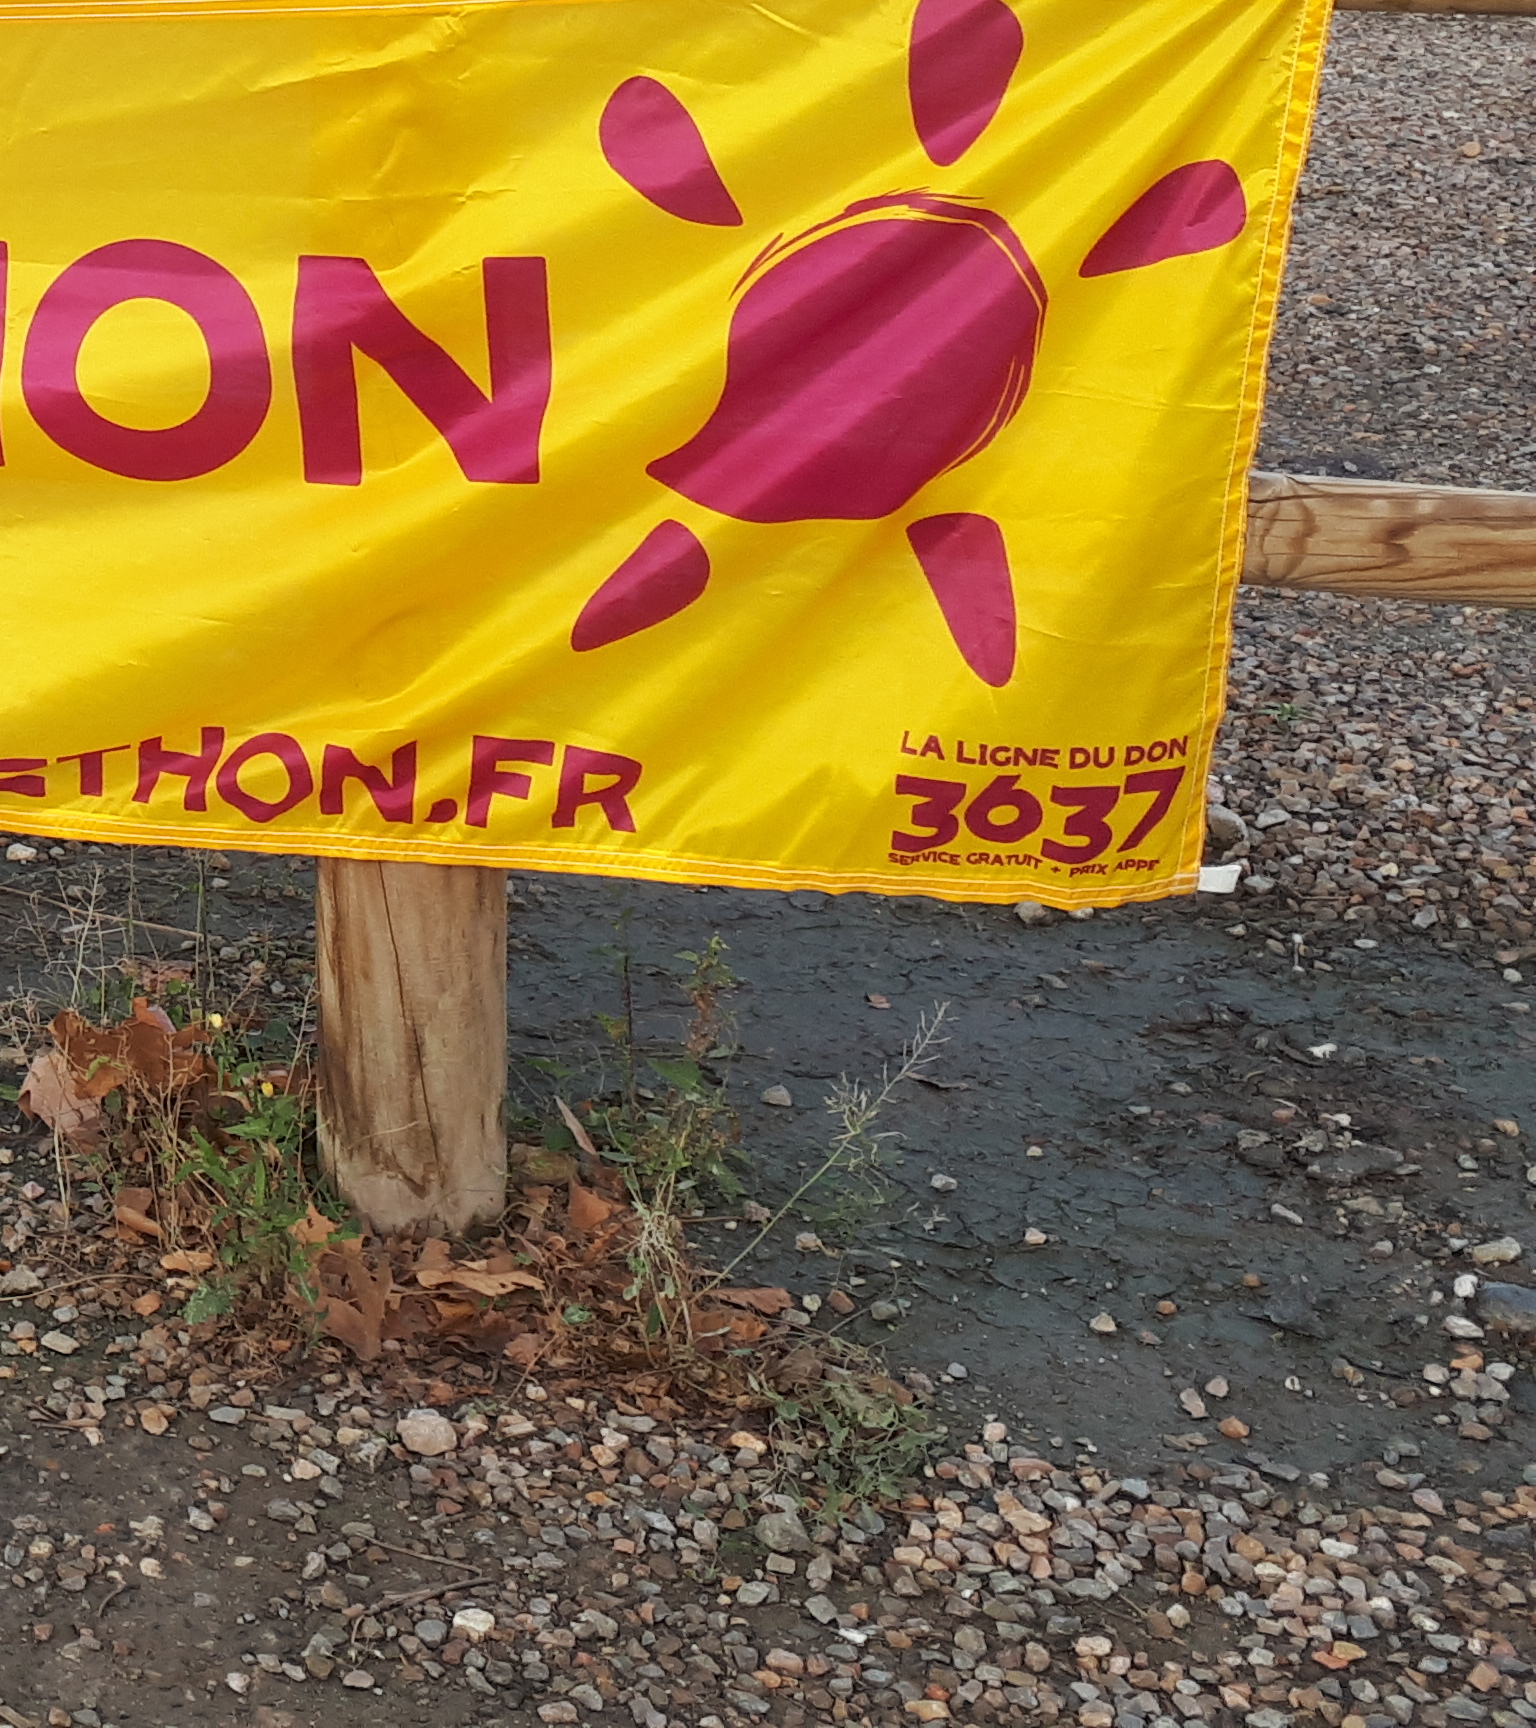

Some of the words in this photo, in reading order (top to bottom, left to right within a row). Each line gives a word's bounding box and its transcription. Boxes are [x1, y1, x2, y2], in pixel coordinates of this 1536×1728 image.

[900, 730, 945, 761] LA
[956, 740, 1061, 769] LIGNE
[1068, 746, 1116, 770] DU
[1124, 735, 1189, 767] DON
[891, 766, 1187, 865] 3637
[888, 851, 962, 866] SERVICE
[966, 852, 1043, 870] GRATUIT
[1069, 863, 1108, 879] PRIX
